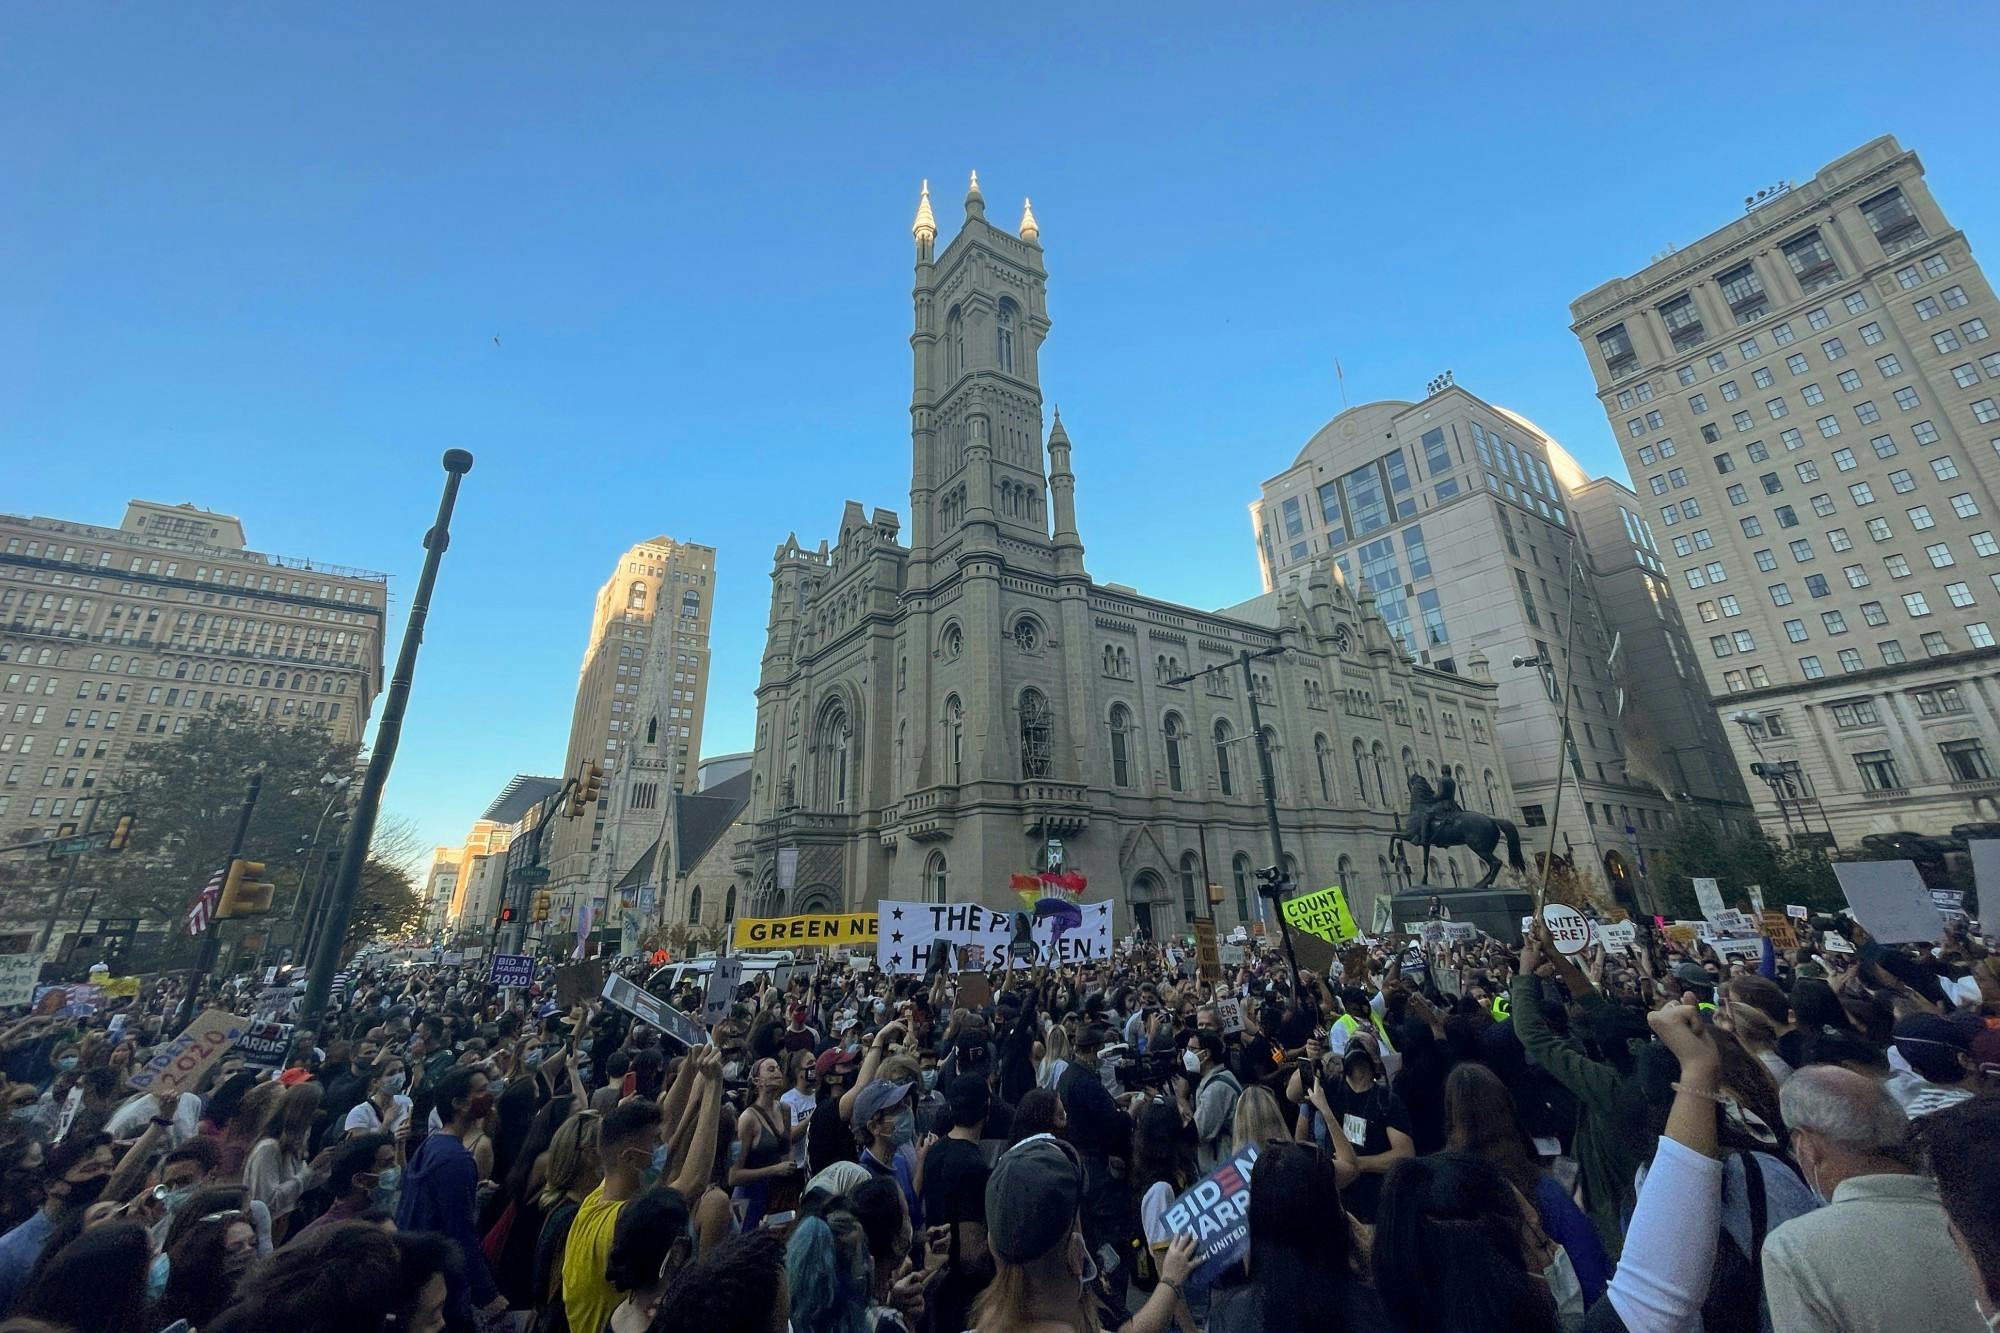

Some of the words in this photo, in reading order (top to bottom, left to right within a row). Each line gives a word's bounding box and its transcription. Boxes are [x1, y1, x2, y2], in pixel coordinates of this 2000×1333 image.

[1287, 891, 1337, 917] COUNT
[750, 919, 839, 941] GREEN
[850, 918, 878, 936] NE
[929, 905, 983, 931] THE
[1293, 907, 1340, 930] EVERY
[1548, 916, 1583, 928] NITE
[1552, 929, 1585, 941] ERE!
[493, 974, 528, 986] 2020
[496, 966, 529, 974] HARRIS
[235, 1035, 287, 1053] ARRIS
[162, 1031, 225, 1087] 2020
[1210, 1225, 1247, 1255] UNITED
